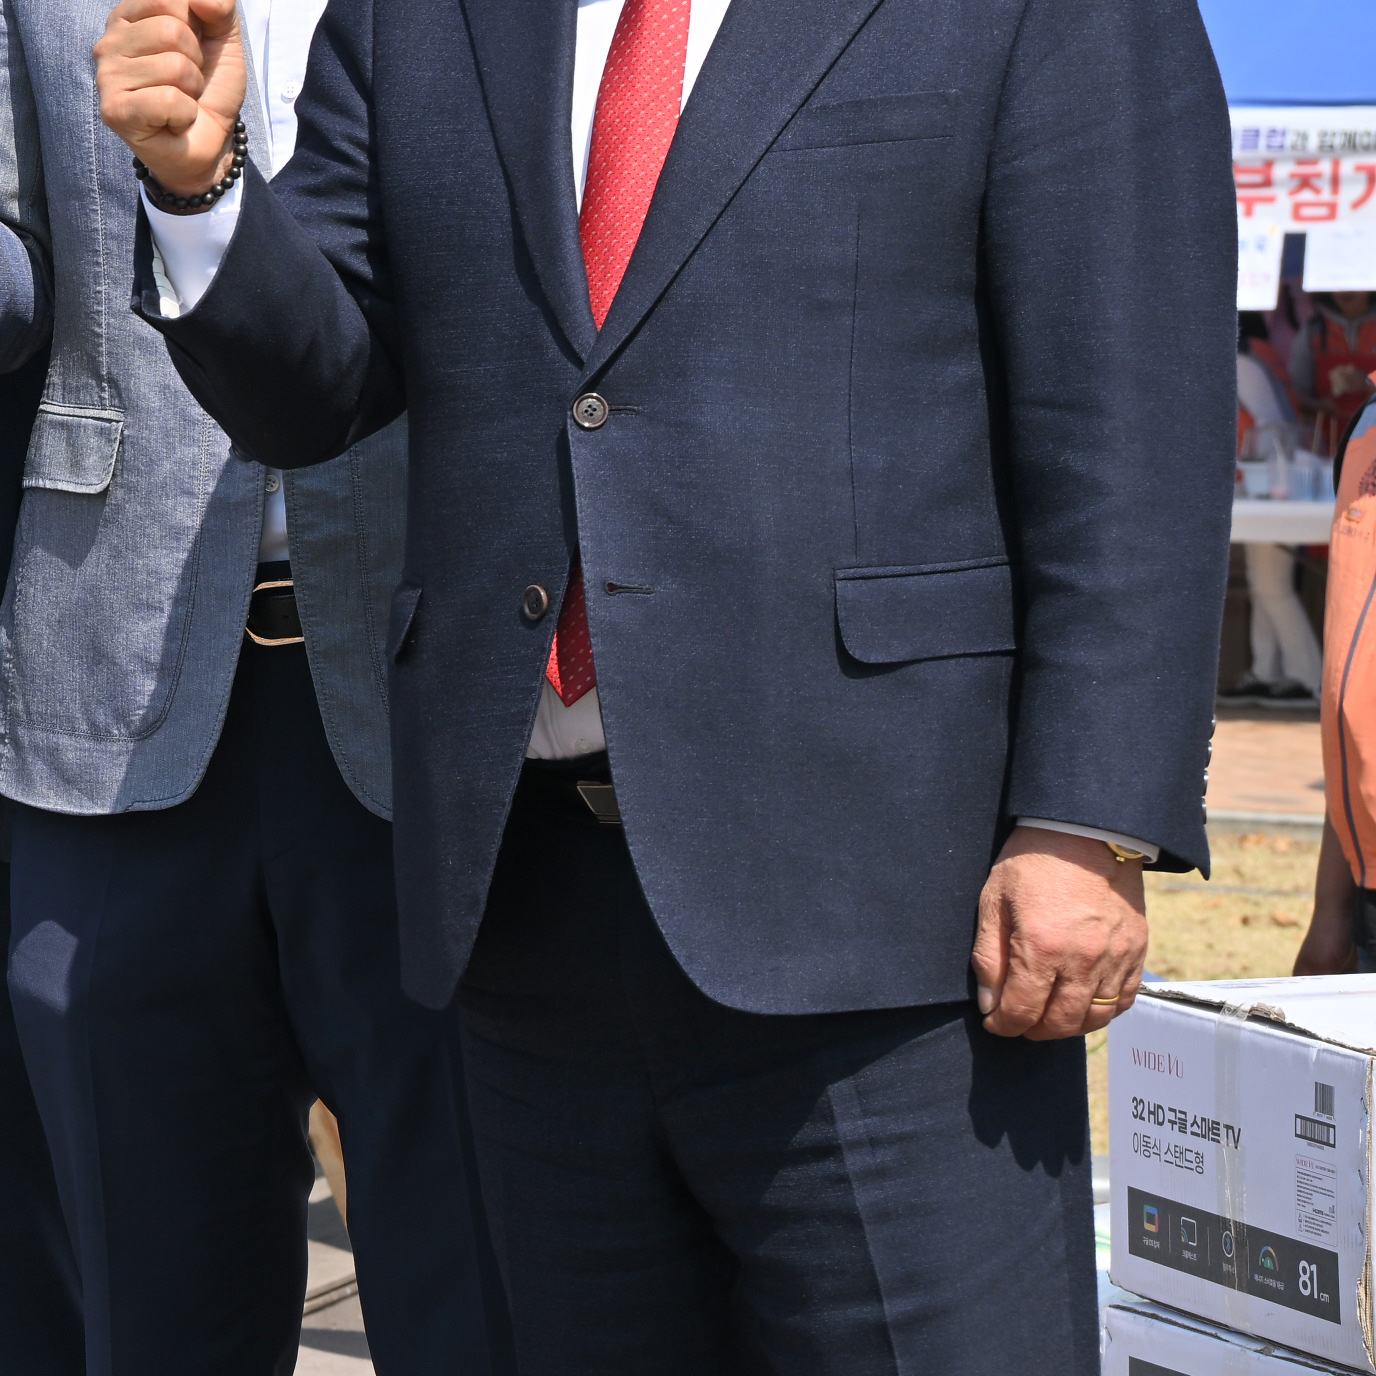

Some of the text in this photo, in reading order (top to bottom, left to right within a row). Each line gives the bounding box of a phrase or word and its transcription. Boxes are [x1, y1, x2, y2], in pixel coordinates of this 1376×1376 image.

[1132, 1096, 1241, 1150] 32 HD 구글 스마트 TV
[1133, 1132, 1205, 1175] 이동식 스탠드형
[1299, 1260, 1330, 1303] 81 cm
